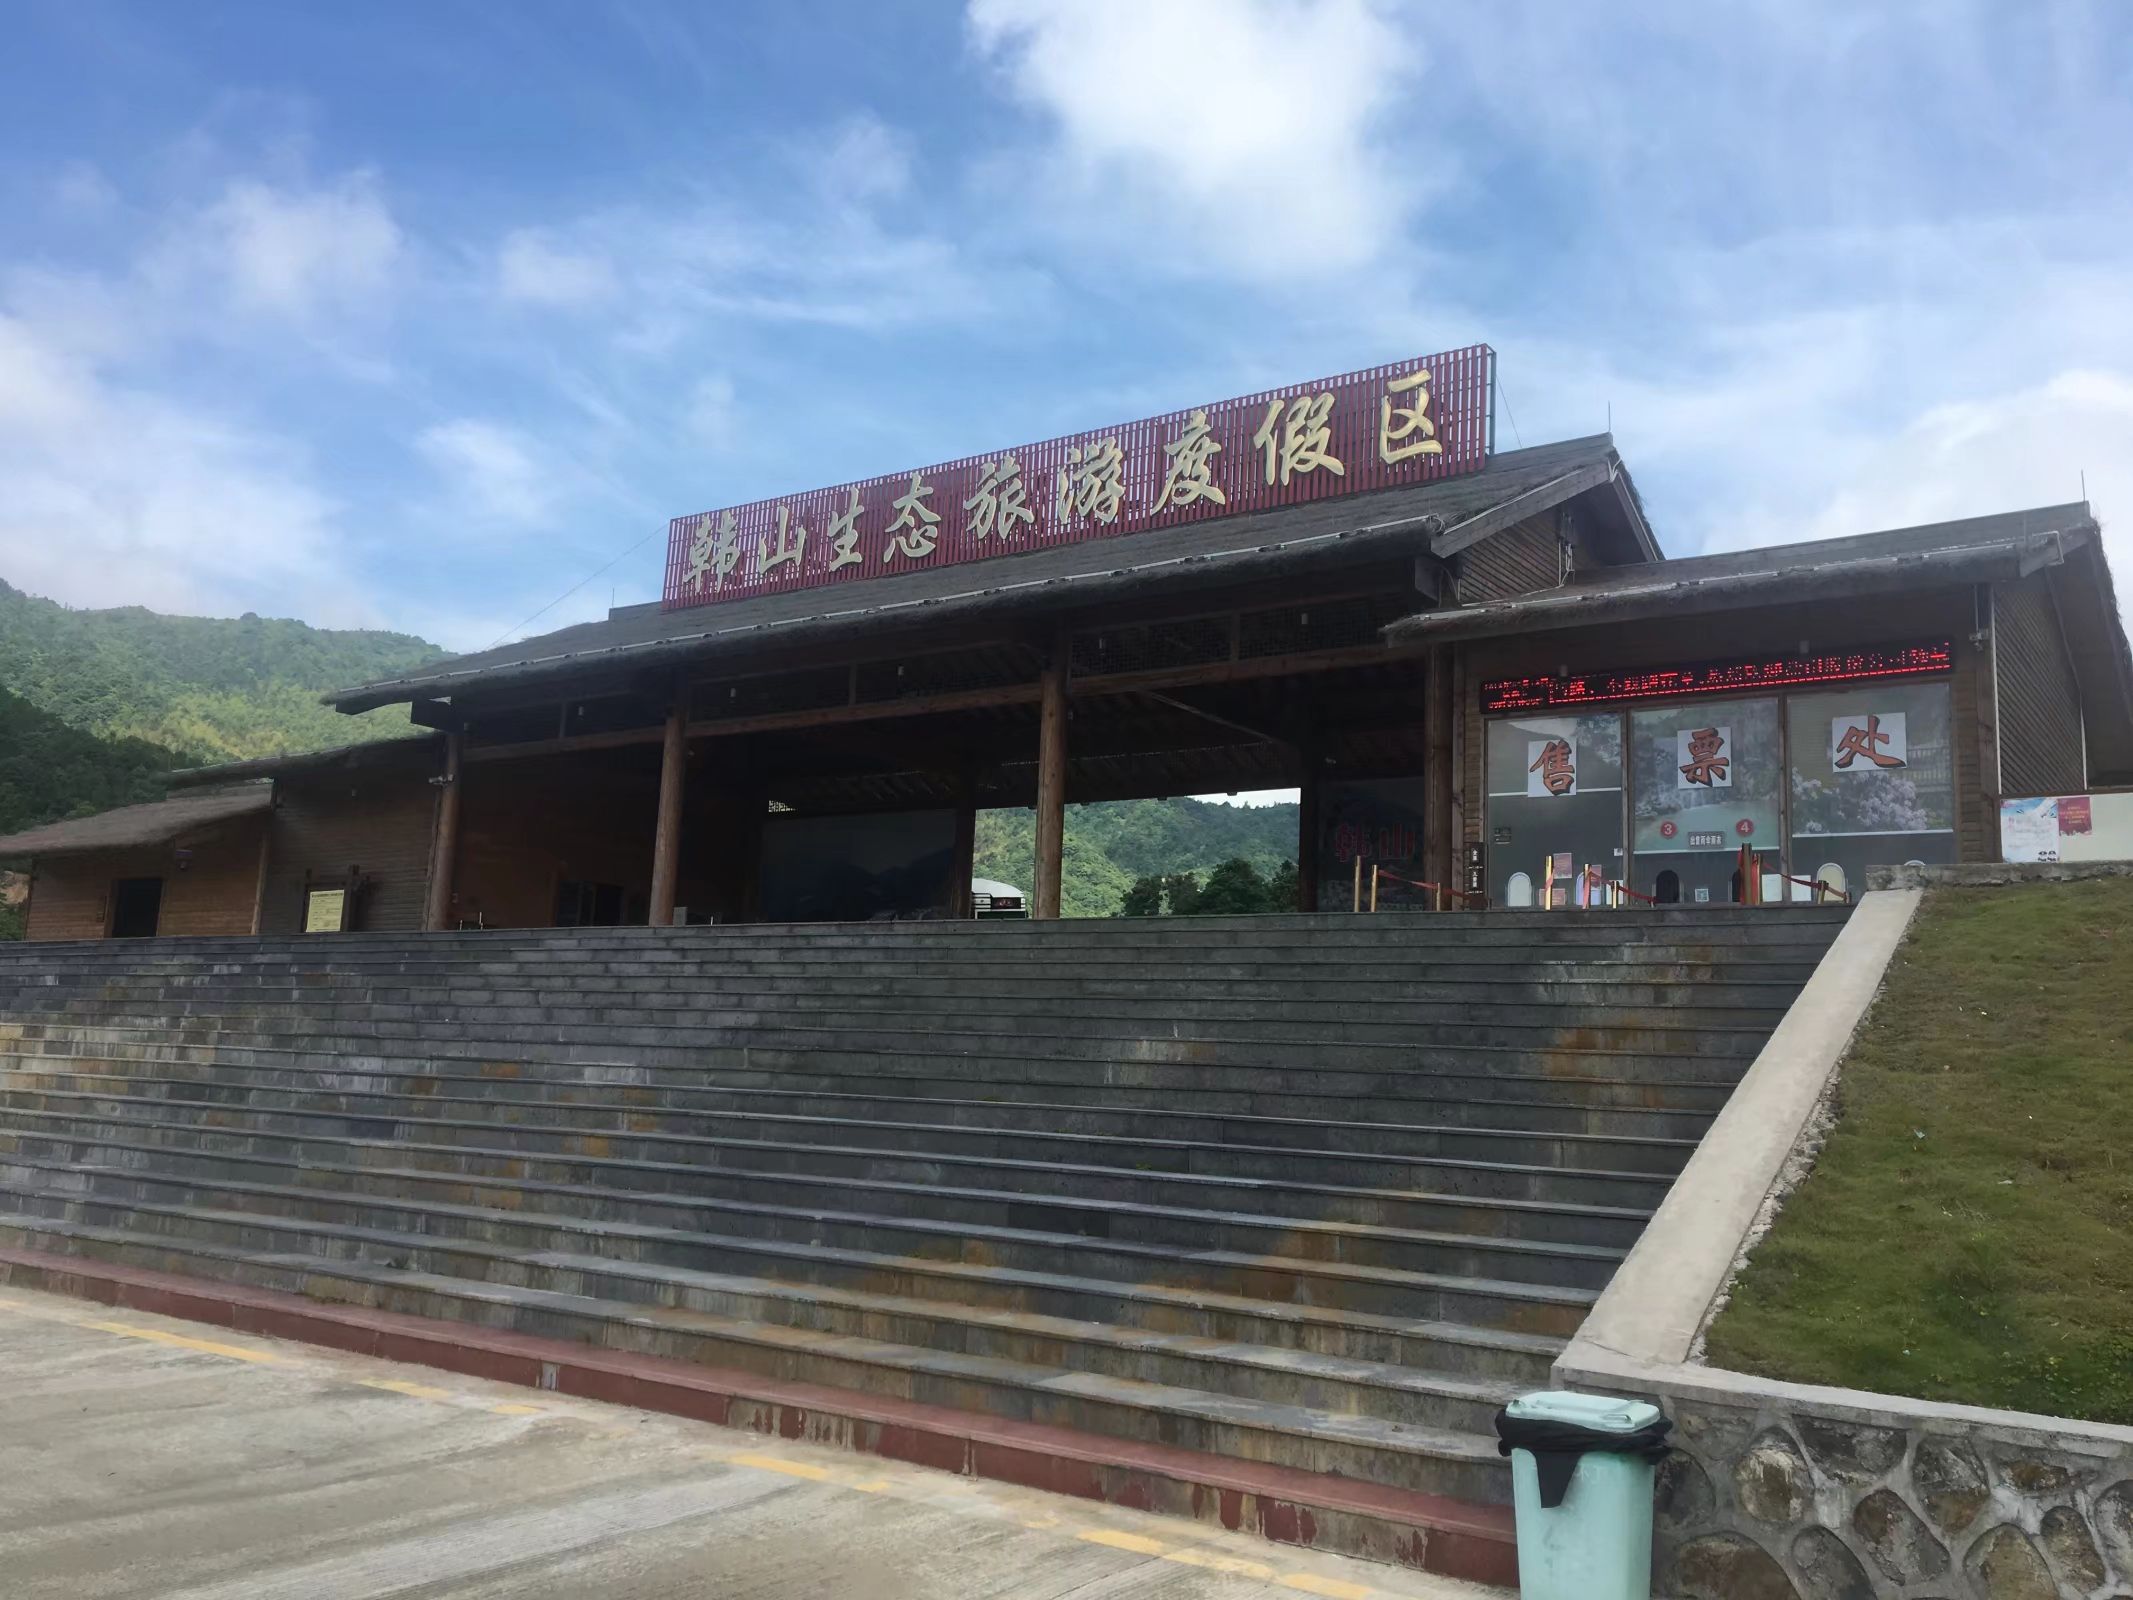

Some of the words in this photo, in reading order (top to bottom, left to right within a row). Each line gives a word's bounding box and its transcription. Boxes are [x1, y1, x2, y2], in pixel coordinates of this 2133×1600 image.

[683, 369, 1443, 595] 韩山生态旅游度假区
[1529, 715, 1906, 795] 售票处
